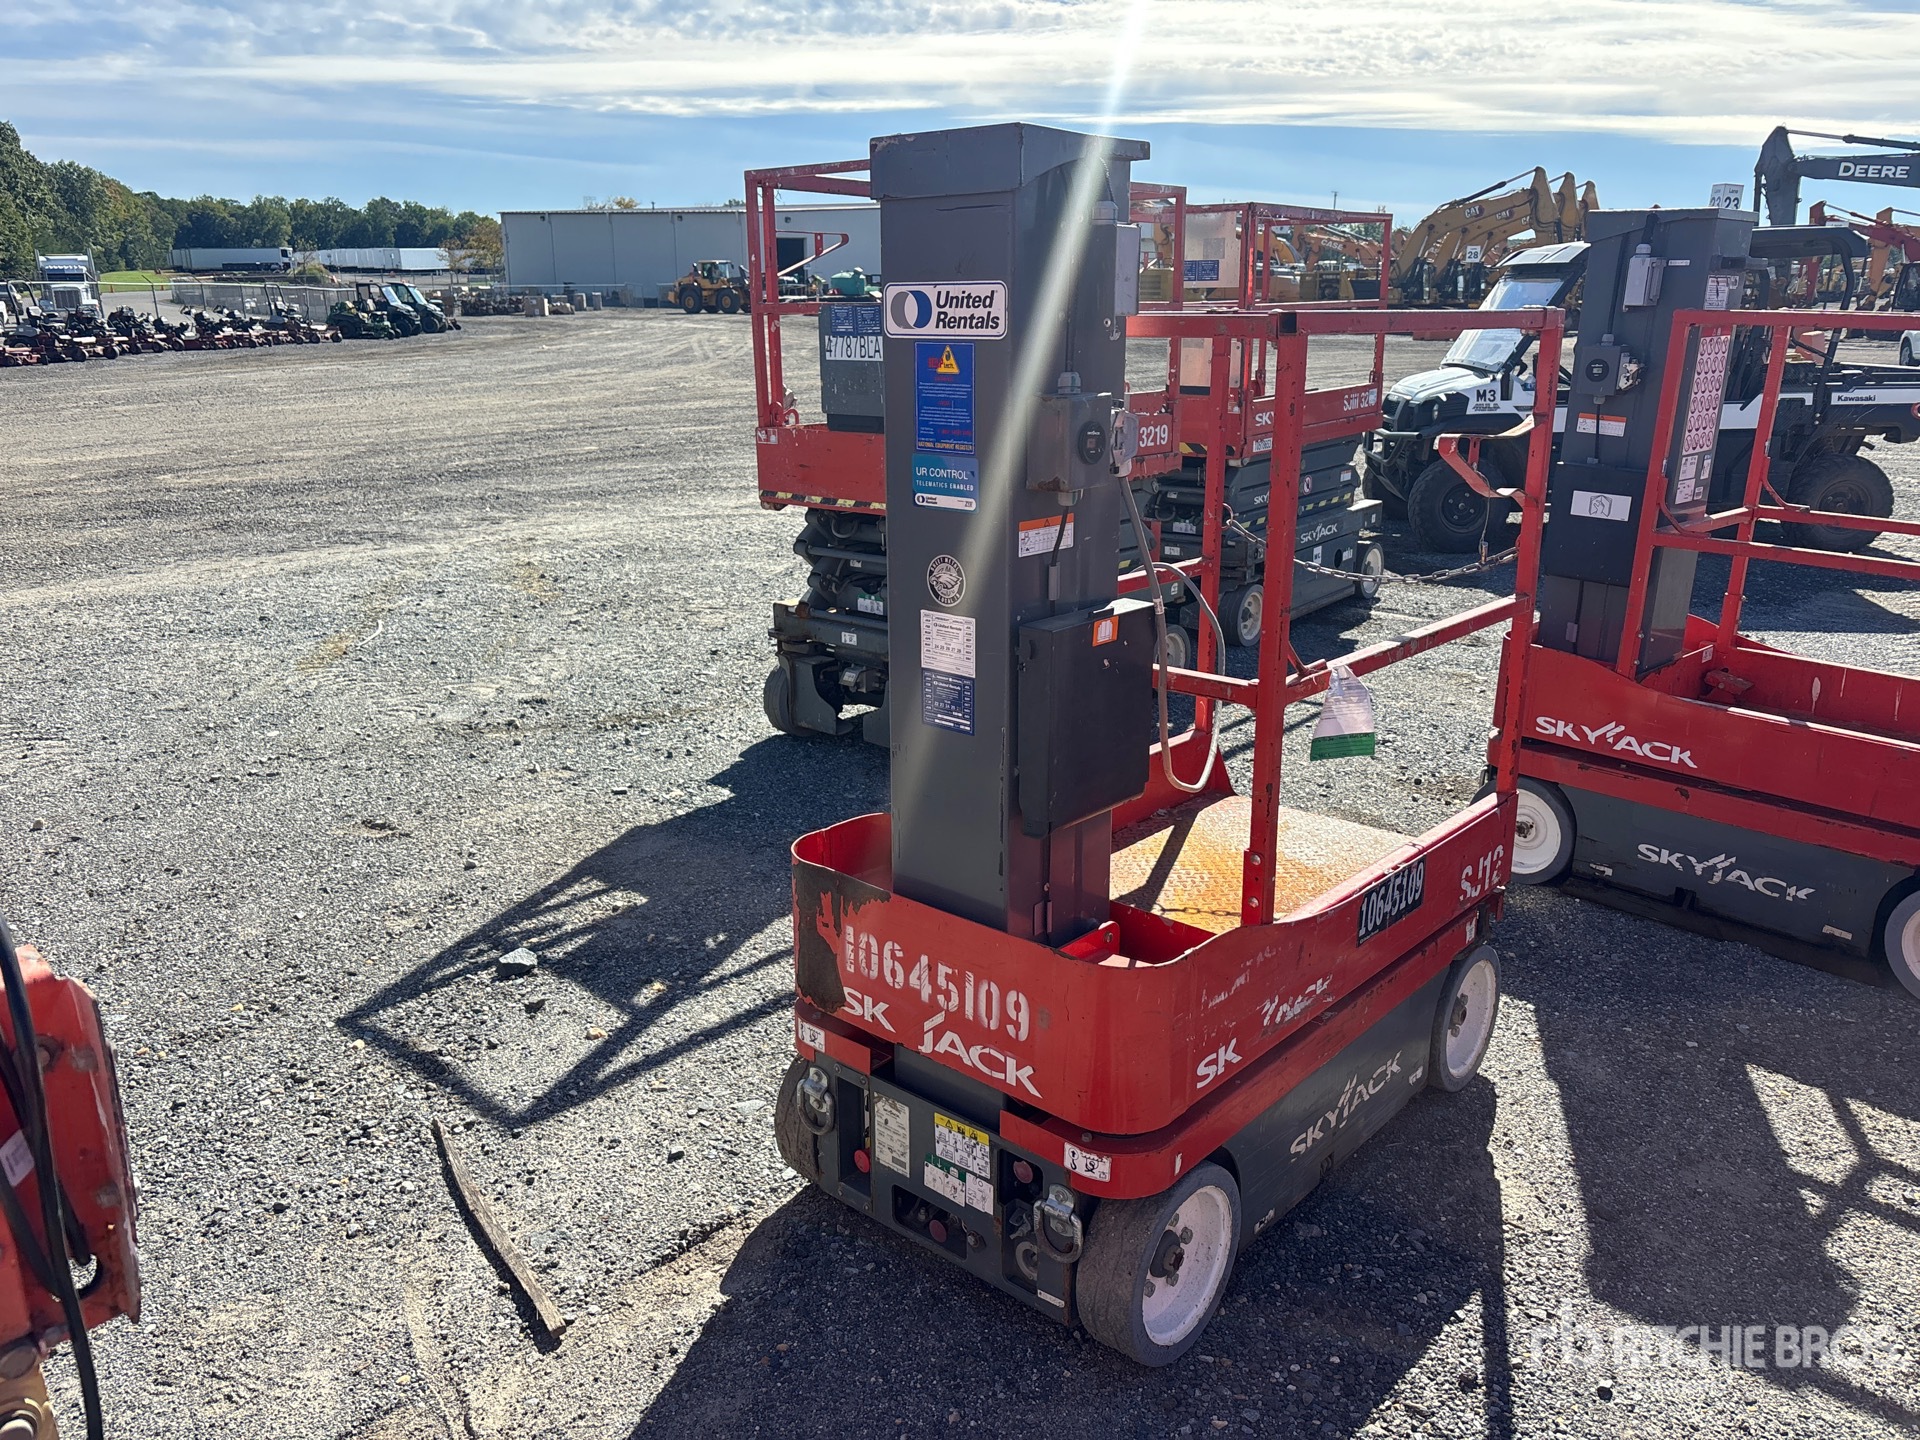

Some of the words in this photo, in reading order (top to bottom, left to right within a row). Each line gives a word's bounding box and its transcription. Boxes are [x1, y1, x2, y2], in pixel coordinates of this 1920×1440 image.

[1838, 161, 1910, 179] DEERE
[1724, 196, 1740, 209] 23
[1465, 206, 1480, 219] CAT
[1497, 210, 1510, 220] CAT
[1321, 239, 1344, 251] CASE
[1467, 251, 1479, 259] 28
[935, 289, 995, 309] United
[935, 311, 1000, 329] Rentals
[1476, 389, 1497, 402] M3
[1139, 424, 1168, 448] 3219
[915, 467, 928, 476] UR
[929, 468, 968, 480] CONTROL
[916, 480, 948, 489] TELEMATICS
[950, 483, 974, 491] ENABLED
[1300, 522, 1338, 544] SKYJACK
[1536, 716, 1698, 769] SKYJACK
[1637, 843, 1816, 902] SKYJACK
[1358, 861, 1425, 938] 10645109
[845, 925, 1030, 1042] 10645109
[1290, 1050, 1402, 1162] SKYJACK
